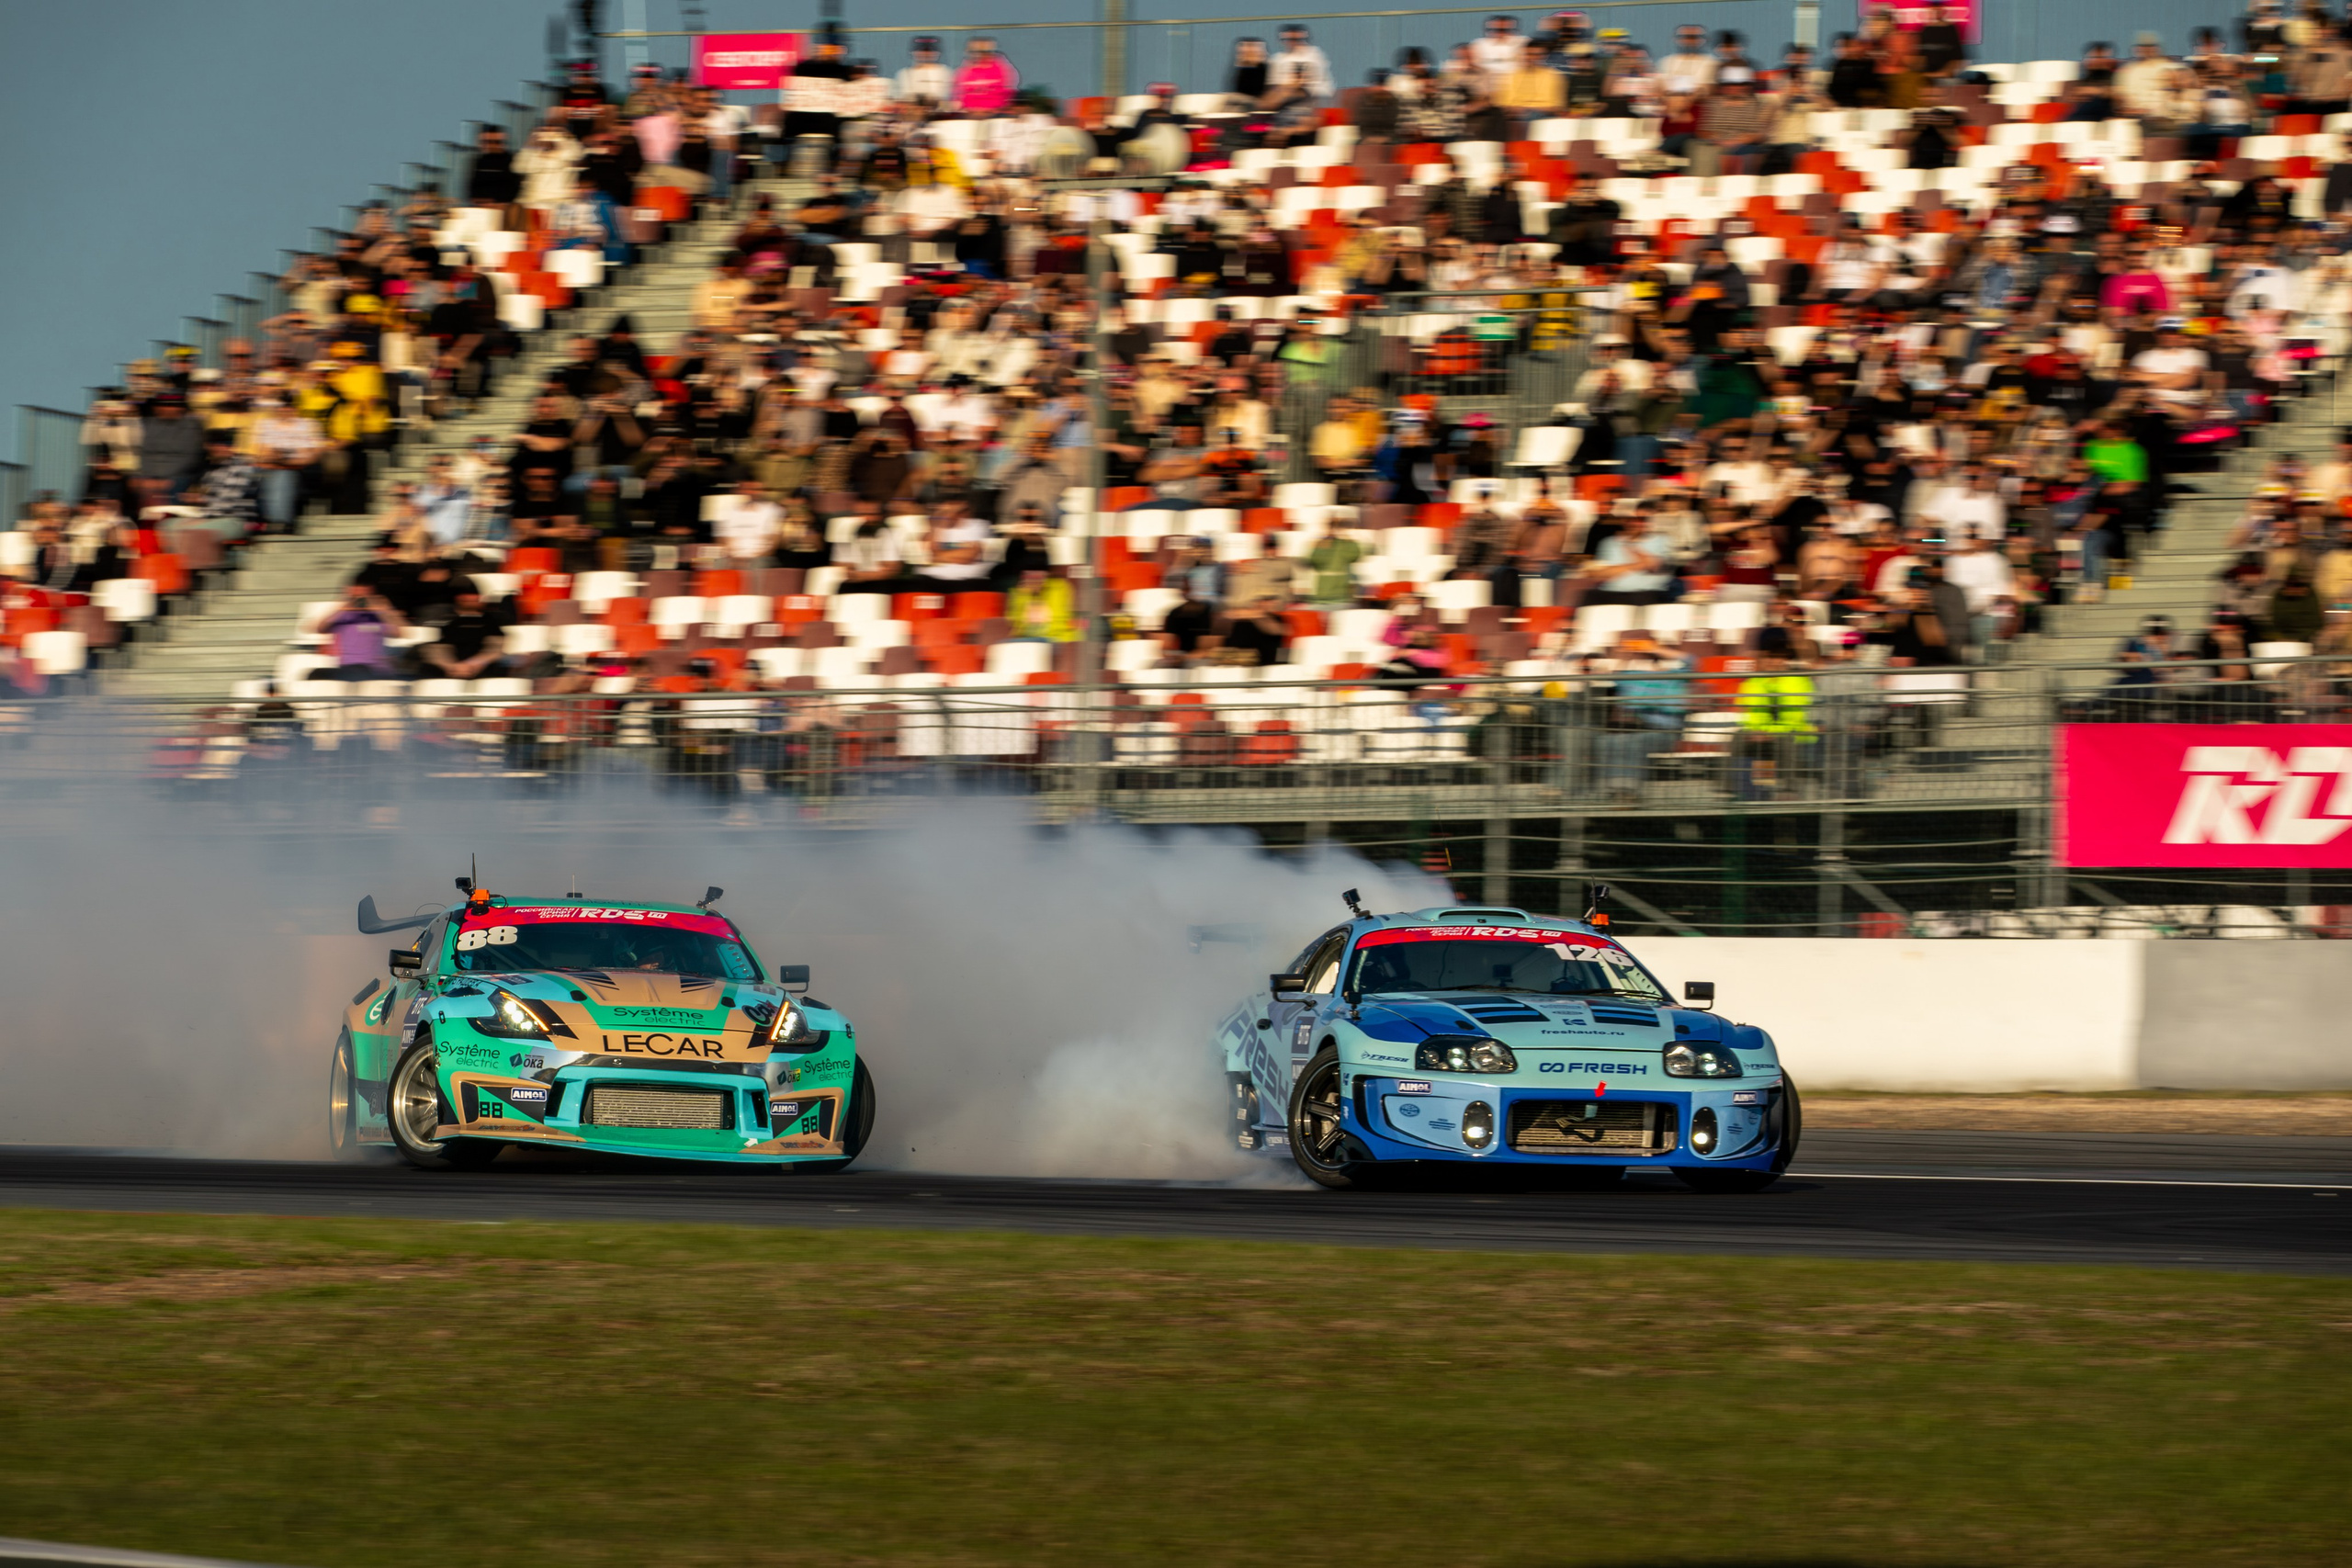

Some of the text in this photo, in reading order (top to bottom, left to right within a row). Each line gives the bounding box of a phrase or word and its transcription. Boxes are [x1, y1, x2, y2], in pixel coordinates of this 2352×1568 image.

[579, 908, 645, 920] RDS
[457, 926, 518, 951] 88
[1471, 926, 1539, 938] RDS
[1544, 942, 1635, 966] 126
[613, 1007, 704, 1021] Systême
[644, 1016, 706, 1027] electric
[438, 1041, 501, 1060] Systême
[603, 1033, 725, 1059] LECAR
[456, 1056, 500, 1069] electric
[804, 1058, 851, 1075] Systême
[1567, 1063, 1647, 1075] FRESH
[819, 1070, 854, 1082] electric
[512, 1089, 545, 1100] AIMOL
[480, 1101, 503, 1119] 88
[771, 1105, 797, 1113] AIMOL
[801, 1115, 819, 1135] 88
